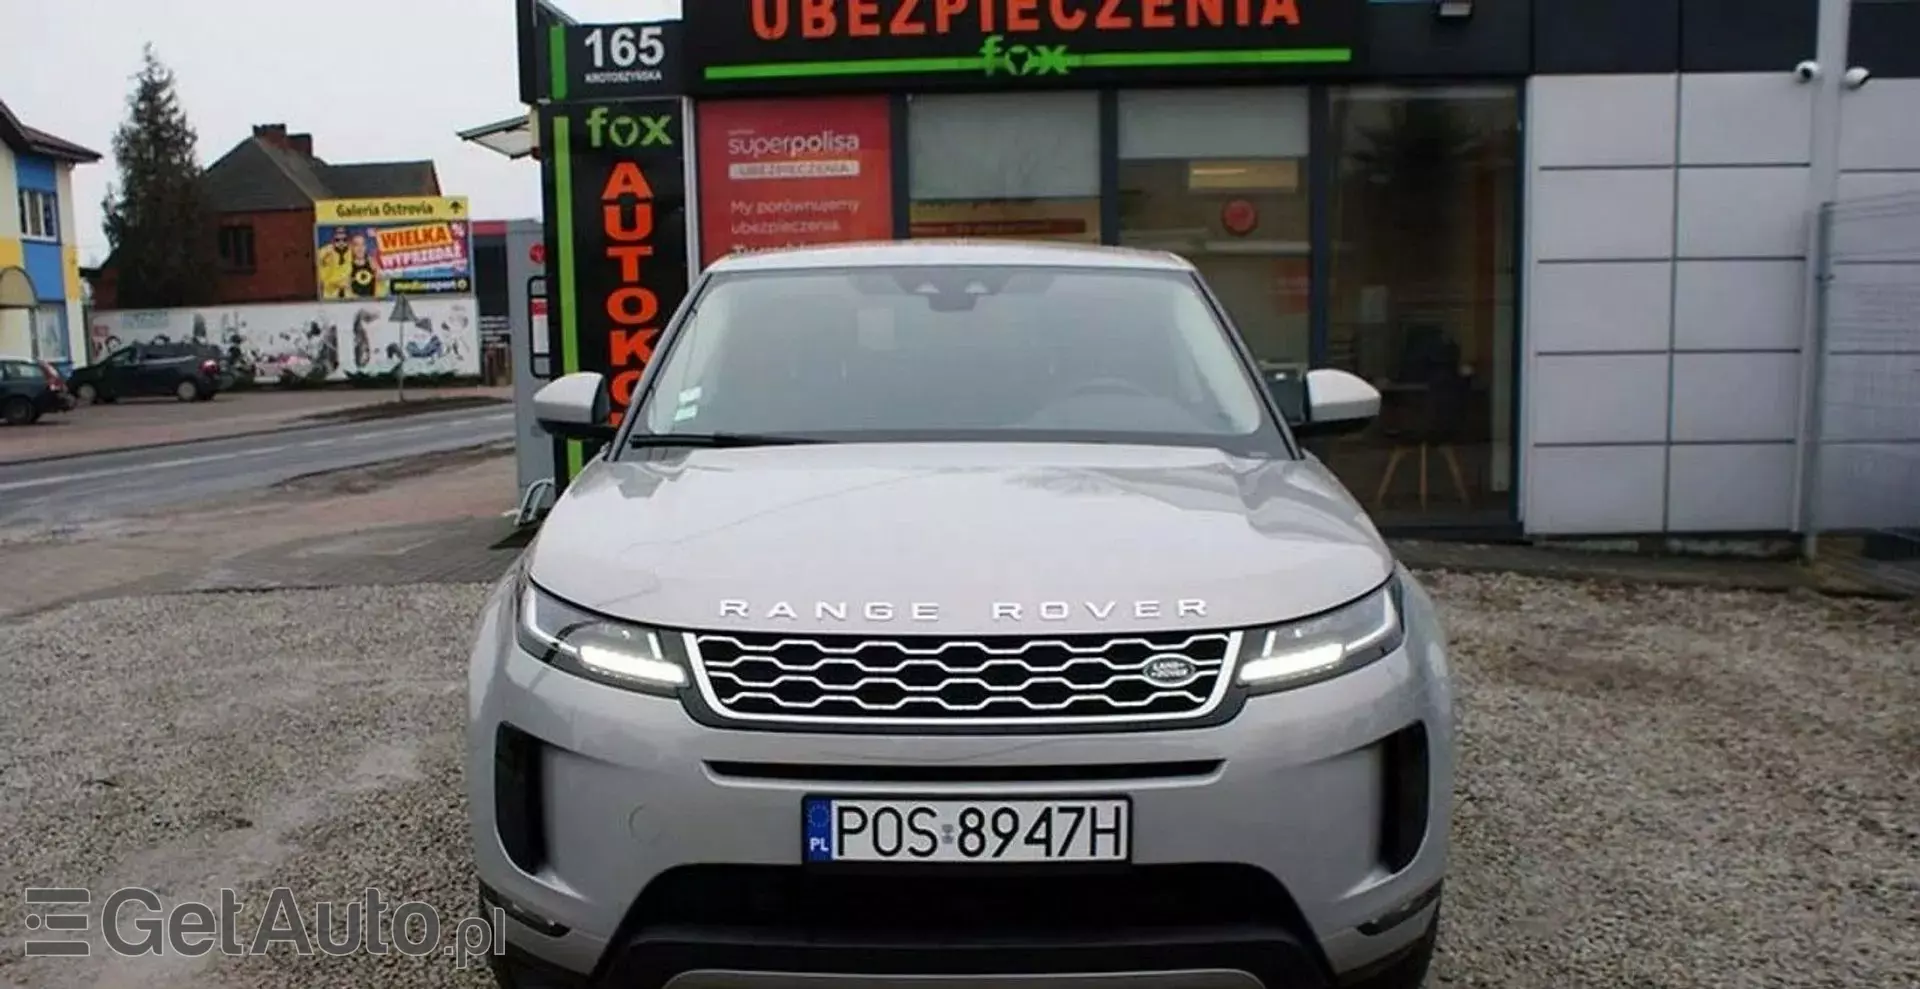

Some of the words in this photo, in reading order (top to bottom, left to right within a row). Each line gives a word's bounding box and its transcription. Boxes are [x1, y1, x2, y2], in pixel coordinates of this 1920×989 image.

[752, 0, 1300, 40] UBEZPIECZENIA
[584, 26, 665, 68] 165
[980, 35, 1069, 76] fox
[586, 107, 673, 147] fox
[728, 130, 860, 158] superpolisa
[336, 203, 380, 217] Galeria
[382, 200, 434, 216] Ostrovia
[730, 200, 752, 215] My
[381, 226, 448, 249] WIELKA
[602, 162, 659, 426] AUTOKO
[719, 599, 940, 622] RANGE
[992, 598, 1210, 621] ROVER
[810, 837, 830, 851] PL
[837, 805, 938, 858] POS
[957, 805, 1122, 858] 8947H
